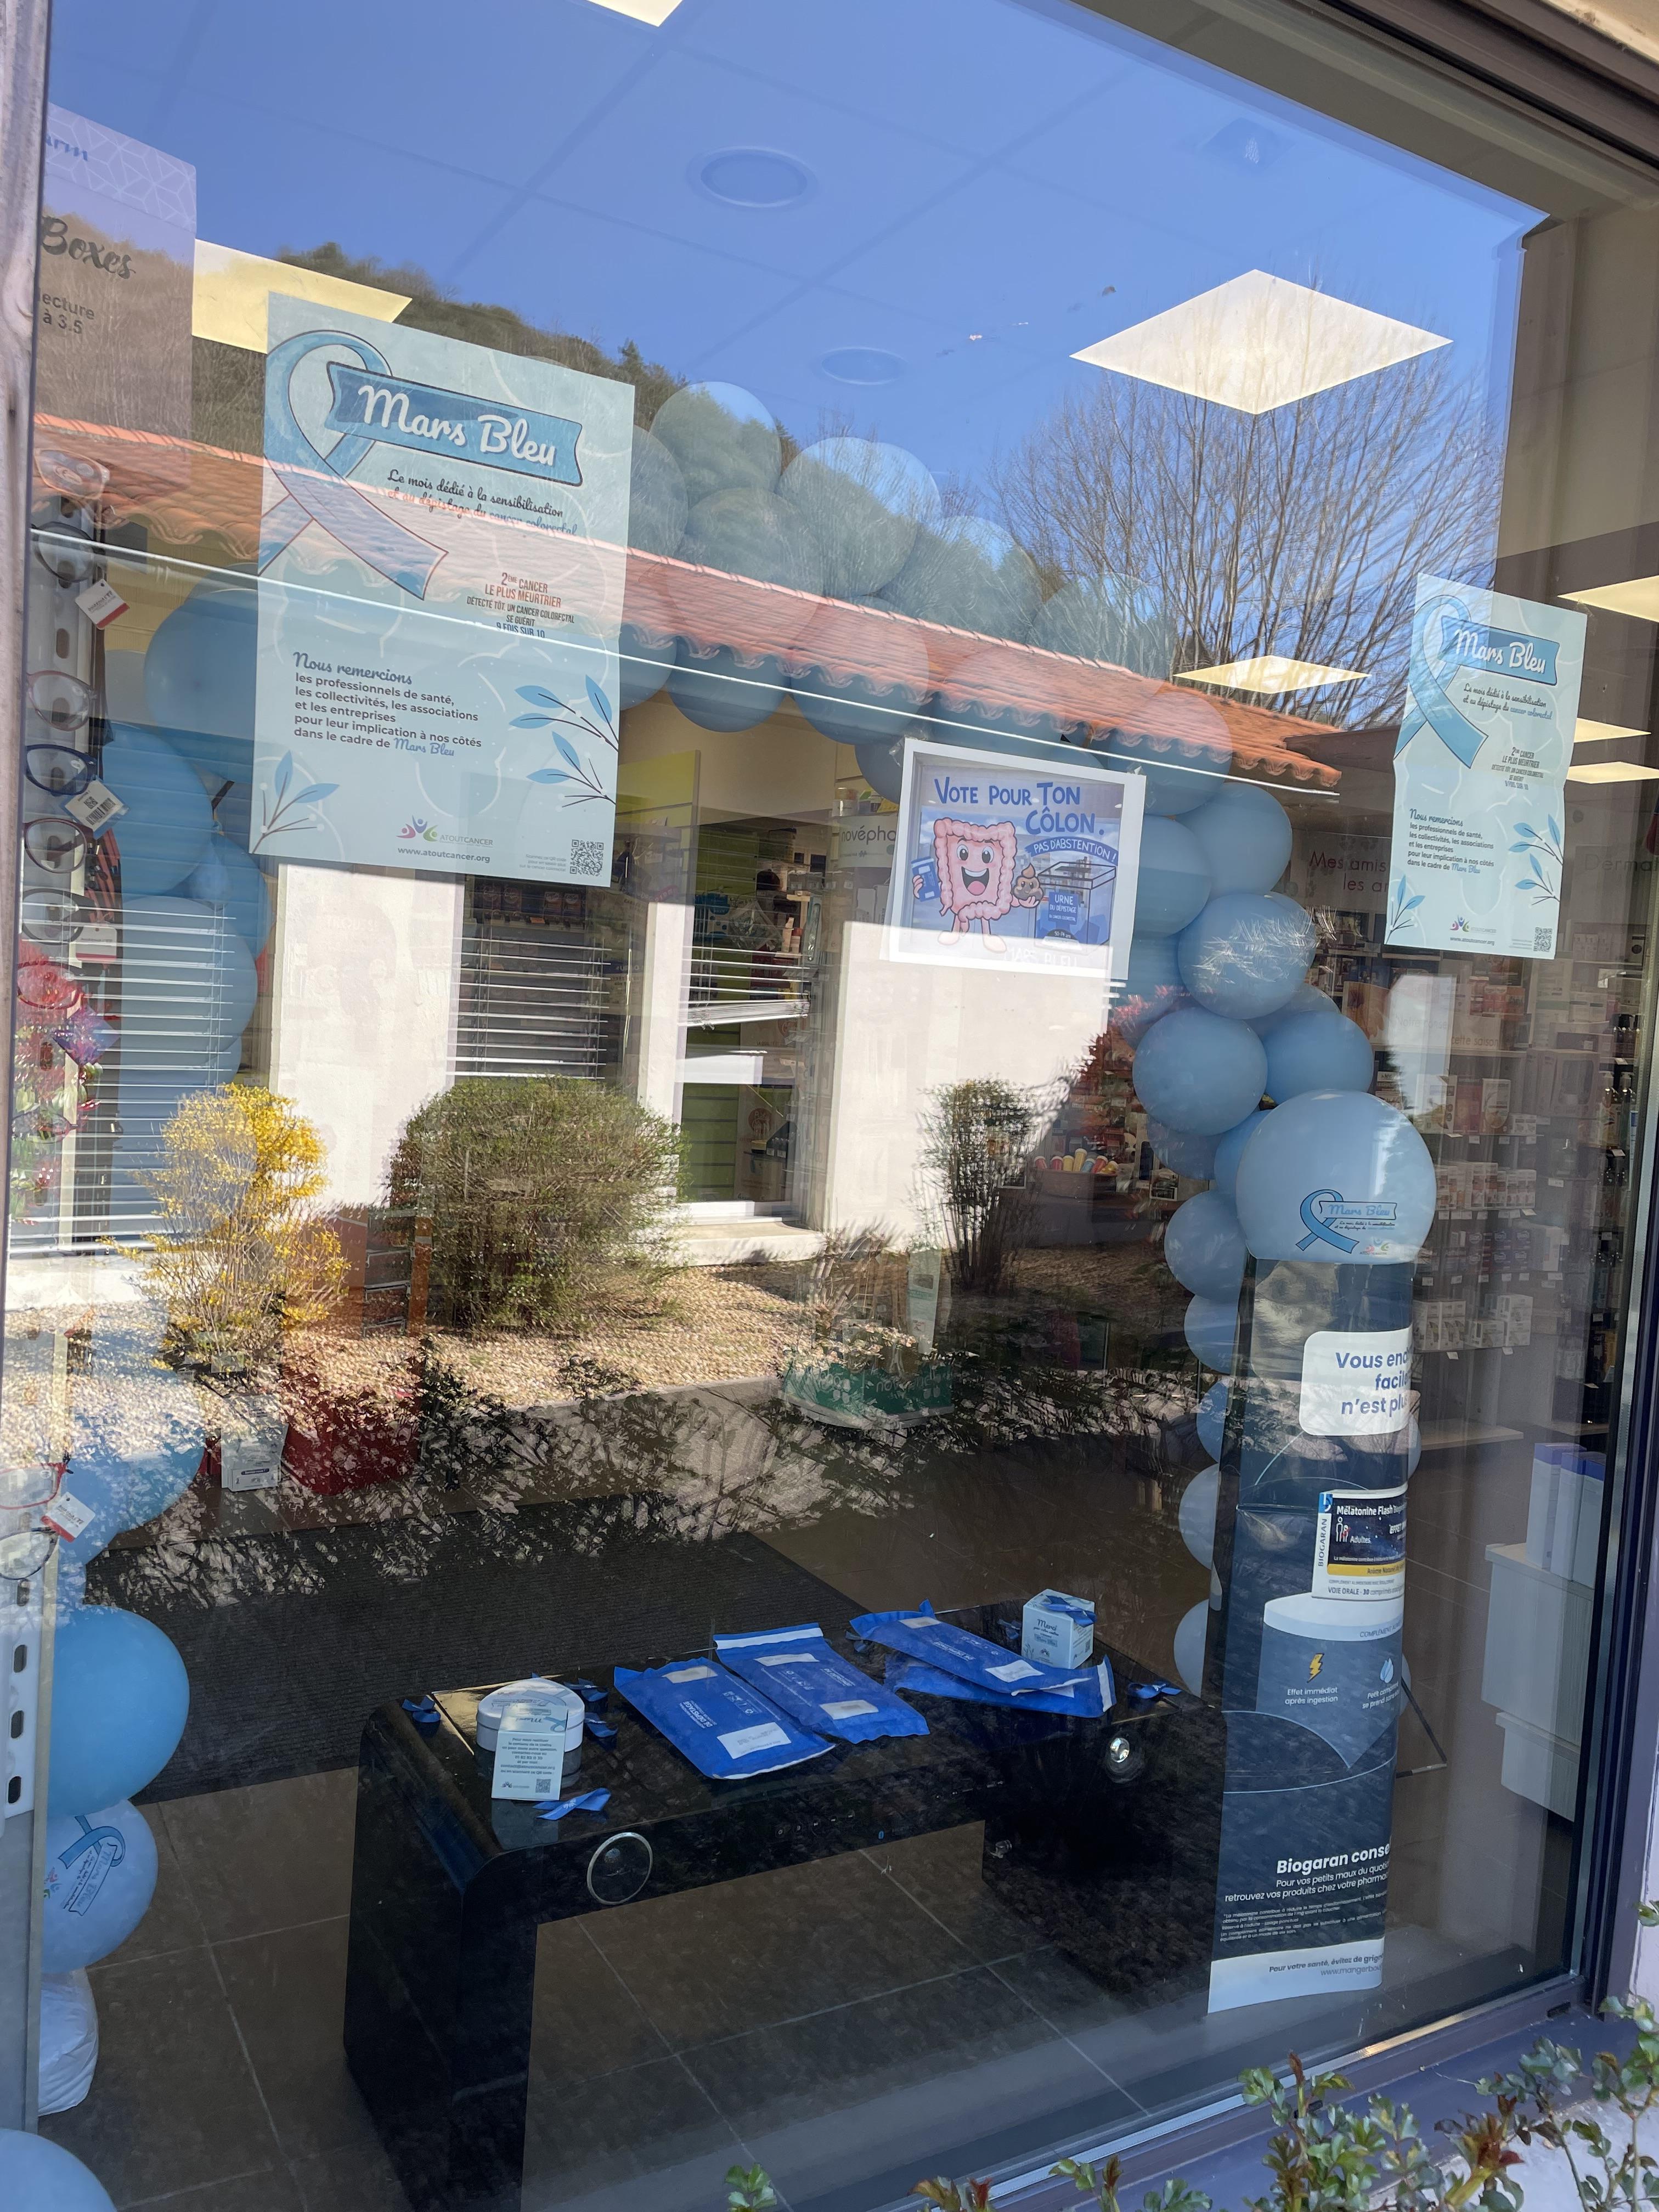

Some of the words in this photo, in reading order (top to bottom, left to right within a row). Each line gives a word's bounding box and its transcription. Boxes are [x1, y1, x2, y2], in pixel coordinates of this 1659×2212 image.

[41, 216, 136, 279] Boxes
[42, 292, 94, 320] ecture
[358, 385, 465, 448] Mars
[478, 415, 557, 467] Bleu
[387, 469, 405, 483] Le
[408, 477, 432, 489] mois
[437, 479, 464, 496] dédié
[467, 486, 473, 498] à
[477, 487, 487, 501] la
[490, 495, 563, 518] sensibilisation
[419, 492, 470, 519] dépistage
[490, 512, 523, 523] cancer
[526, 516, 578, 537] colorectal
[519, 578, 548, 594] CANCER
[485, 584, 494, 595] LE
[496, 586, 516, 600] PLUS
[518, 590, 562, 608] MEURTRIER
[467, 596, 493, 608] DÉTECTÉ
[507, 604, 515, 612] UN
[516, 605, 539, 617] CANCER
[540, 610, 575, 623] COLORECTAL
[506, 614, 514, 623] SE
[515, 616, 535, 627] GUÉRIT
[503, 623, 518, 634] FOIS
[520, 627, 534, 637] SUR
[1454, 629, 1503, 665] Mars
[1510, 641, 1546, 674] Bleu
[293, 651, 332, 673] Nous
[337, 664, 412, 685] remercions
[296, 673, 312, 684] les
[315, 676, 400, 697] professionnels
[404, 689, 417, 699] de
[421, 693, 454, 706] santé,
[1464, 683, 1472, 692] Le
[1473, 687, 1485, 695] mois
[295, 701, 307, 710] et
[311, 702, 327, 713] les
[330, 707, 396, 723] entreprises
[296, 686, 312, 697] les
[315, 690, 388, 710] collectivités,
[392, 700, 407, 711] les
[410, 705, 478, 721] associations
[295, 715, 323, 726] pour
[326, 718, 349, 729] leur
[352, 720, 416, 739] implication
[420, 730, 426, 740] à
[430, 734, 449, 743] nos
[453, 735, 482, 747] côtés
[294, 727, 323, 740] dans
[327, 731, 337, 740] le
[340, 734, 373, 745] cadre
[376, 738, 391, 748] de
[394, 738, 426, 753] Mars
[430, 743, 454, 757] Bleu
[989, 785, 1031, 805] POUR
[1036, 782, 1080, 805] TON
[1409, 809, 1427, 821] Nous
[1429, 815, 1463, 826] remercions
[1419, 824, 1457, 835] professionnels
[440, 834, 493, 845] ATOUTCANCER
[1034, 842, 1049, 854] PAS
[1418, 833, 1451, 844] collectivités,
[1461, 840, 1494, 849] associations
[398, 847, 490, 864] www.atoutcancer.org
[1424, 844, 1453, 853] entreprises
[1309, 851, 1344, 869] Mes
[1350, 859, 1386, 872] amis
[1434, 853, 1463, 862] implication
[1343, 873, 1364, 891] les
[1055, 894, 1074, 905] URNE
[1056, 905, 1077, 913] DÉPISTAGE
[1329, 1204, 1361, 1215] Mars
[1366, 1205, 1390, 1216] Bleu
[1336, 1352, 1383, 1369] Vous
[1341, 1397, 1386, 1414] n'est
[1336, 1505, 1376, 1515] Mélatonine
[1378, 1504, 1393, 1515] Flash
[1318, 1519, 1327, 1566] BIOGARAN
[1037, 1619, 1057, 1631] Merci
[1305, 1686, 1338, 1695] immédiat
[1285, 1696, 1306, 1706] après
[1307, 1695, 1338, 1705] ingestion
[1370, 1697, 1385, 1709] prend
[1277, 1854, 1348, 1876] Biogaran
[1276, 1879, 1295, 1887] Pour
[1312, 1873, 1334, 1885] petits
[1335, 1870, 1357, 1880] maux
[1358, 1866, 1368, 1875] du
[1224, 1893, 1265, 1902] retrouvez
[1266, 1891, 1281, 1899] vos
[1282, 1886, 1316, 1899] produits
[1317, 1883, 1335, 1893] chez
[1337, 1880, 1357, 1889] votre
[1331, 1956, 1352, 1965] évitez
